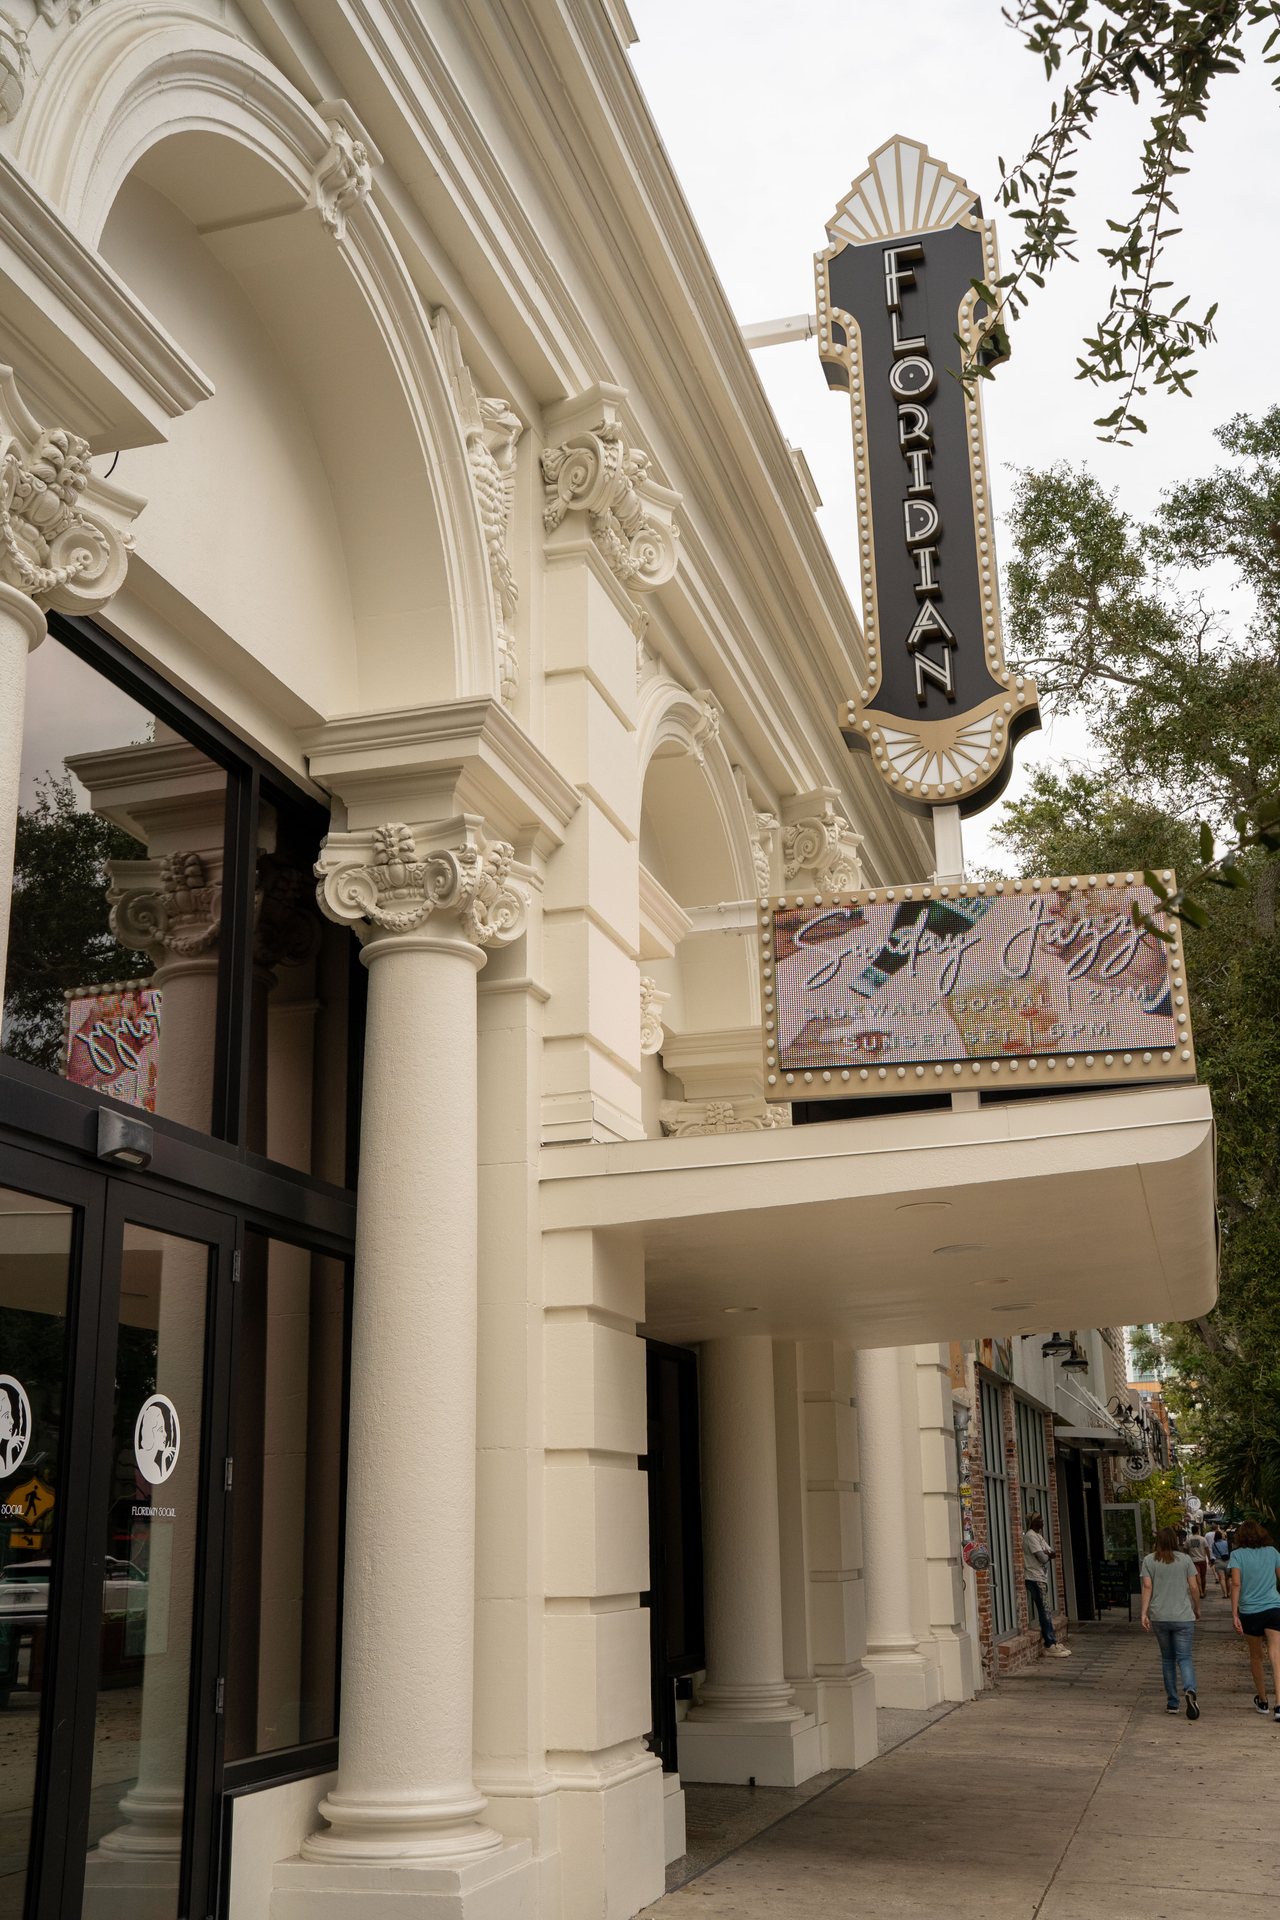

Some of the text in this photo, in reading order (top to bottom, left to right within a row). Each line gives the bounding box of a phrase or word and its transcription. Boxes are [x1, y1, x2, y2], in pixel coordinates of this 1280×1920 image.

[882, 242, 956, 703] FLORIDIAN
[792, 899, 1152, 997] Sunday Jazz
[803, 1000, 943, 1021] SIDEWALK
[951, 994, 1052, 1014] SOCIAL
[1087, 985, 1150, 1006] 2PM
[843, 1031, 951, 1052] SUNSET
[963, 1027, 1013, 1045] SET
